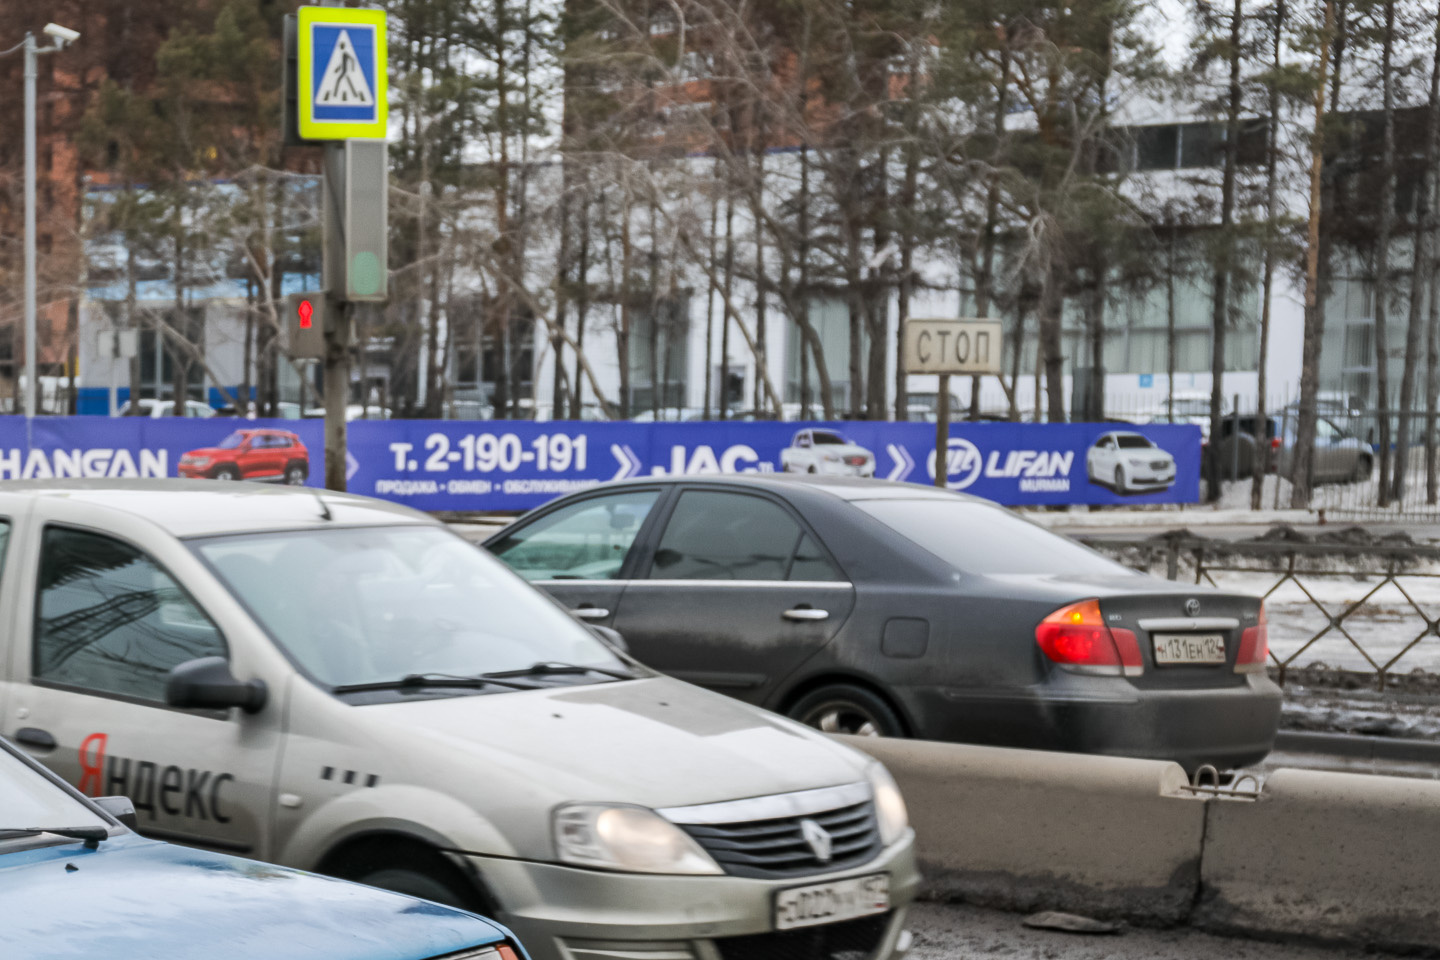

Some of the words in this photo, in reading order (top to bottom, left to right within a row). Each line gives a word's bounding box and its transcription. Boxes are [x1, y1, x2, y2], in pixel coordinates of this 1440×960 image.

[917, 330, 990, 364] СТОП
[424, 433, 587, 472] 2-190-191
[984, 451, 1075, 478] LIFAN
[376, 480, 438, 495] ПРОДАЖА
[448, 480, 491, 494] ОБМЕН
[78, 733, 235, 824] Яндекс
